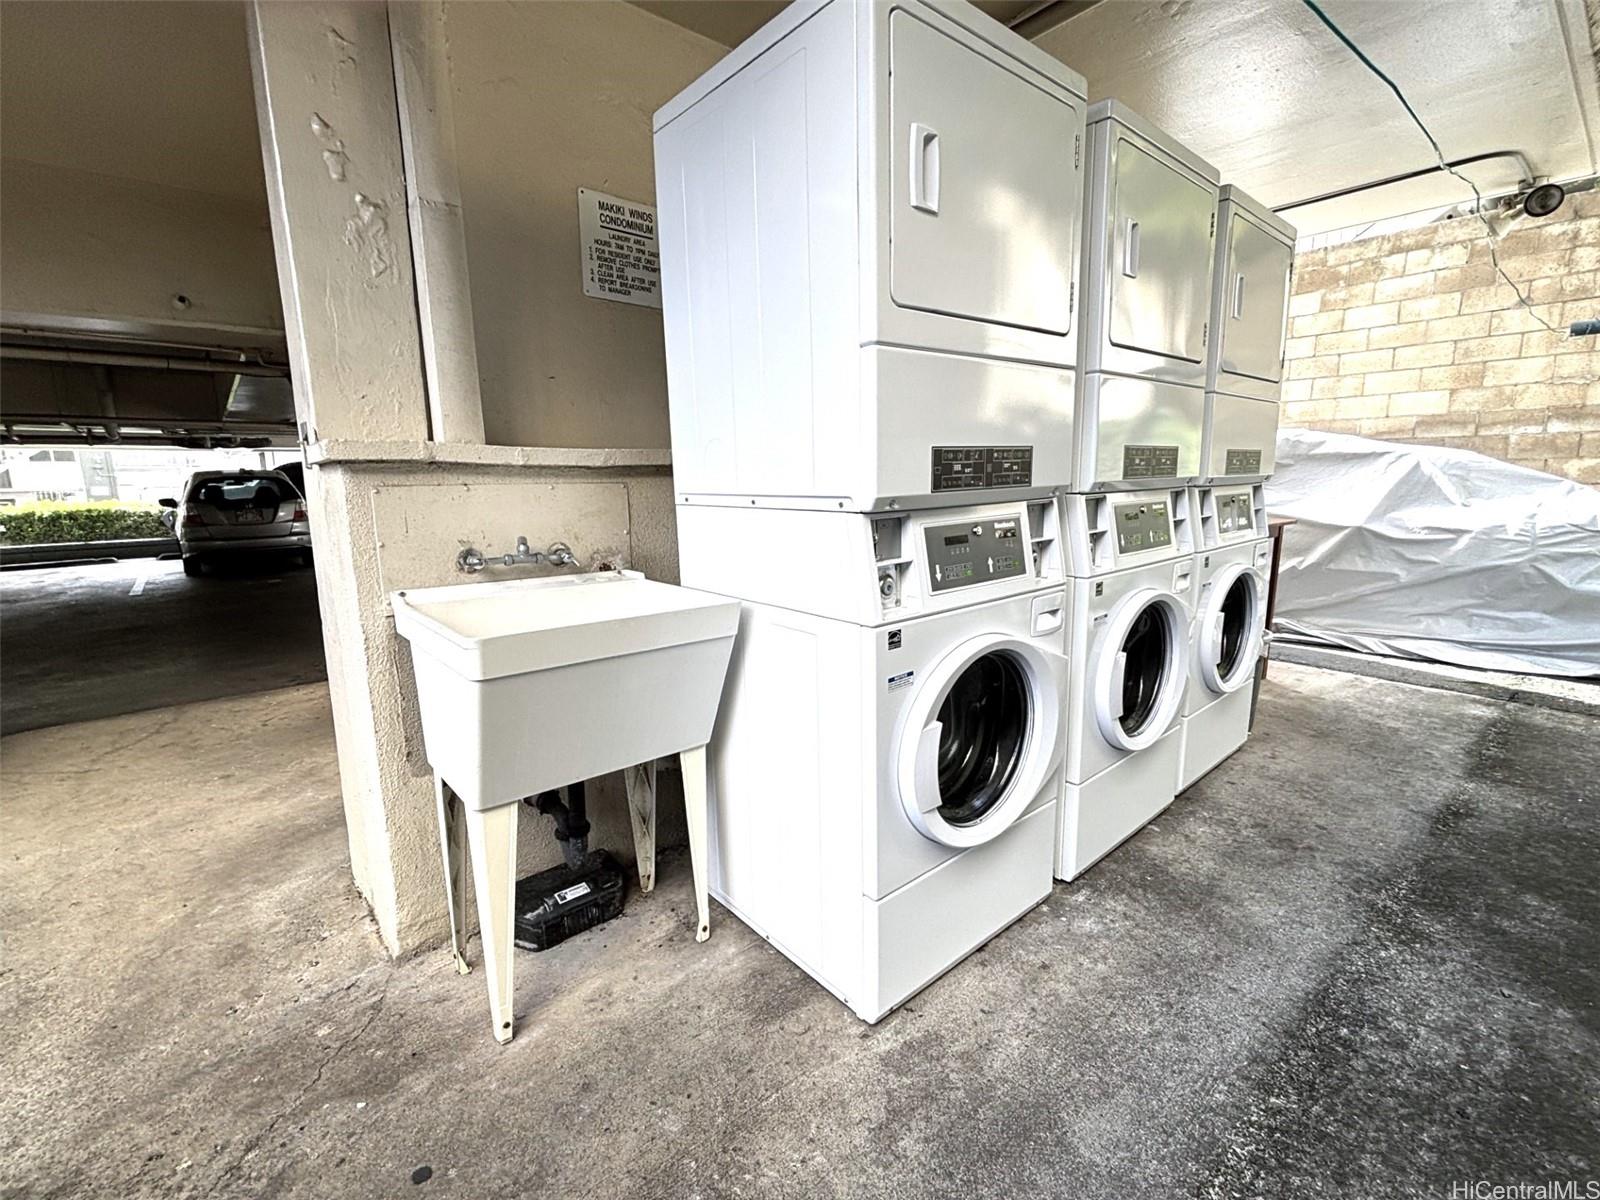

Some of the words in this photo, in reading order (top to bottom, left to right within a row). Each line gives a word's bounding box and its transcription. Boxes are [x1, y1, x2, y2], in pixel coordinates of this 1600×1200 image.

[598, 200, 625, 216] MAKIKI
[628, 208, 653, 223] WINDS
[600, 213, 654, 235] CONDOMINIUM
[608, 233, 631, 243] LAUNDRY
[633, 238, 646, 247] AREA
[626, 245, 634, 253] TO
[595, 247, 606, 255] FOR
[608, 250, 630, 260] RESIDENT
[632, 256, 642, 264] USE
[644, 258, 656, 266] ONLY
[596, 255, 616, 266] REMOVE
[618, 260, 640, 270] CLOTHES
[598, 262, 614, 272] AFTER
[597, 270, 614, 278] CLEAN
[616, 274, 628, 282] AREA
[631, 276, 646, 284] AFTER
[598, 278, 616, 286] REPORT
[608, 286, 632, 296] MANAGER
